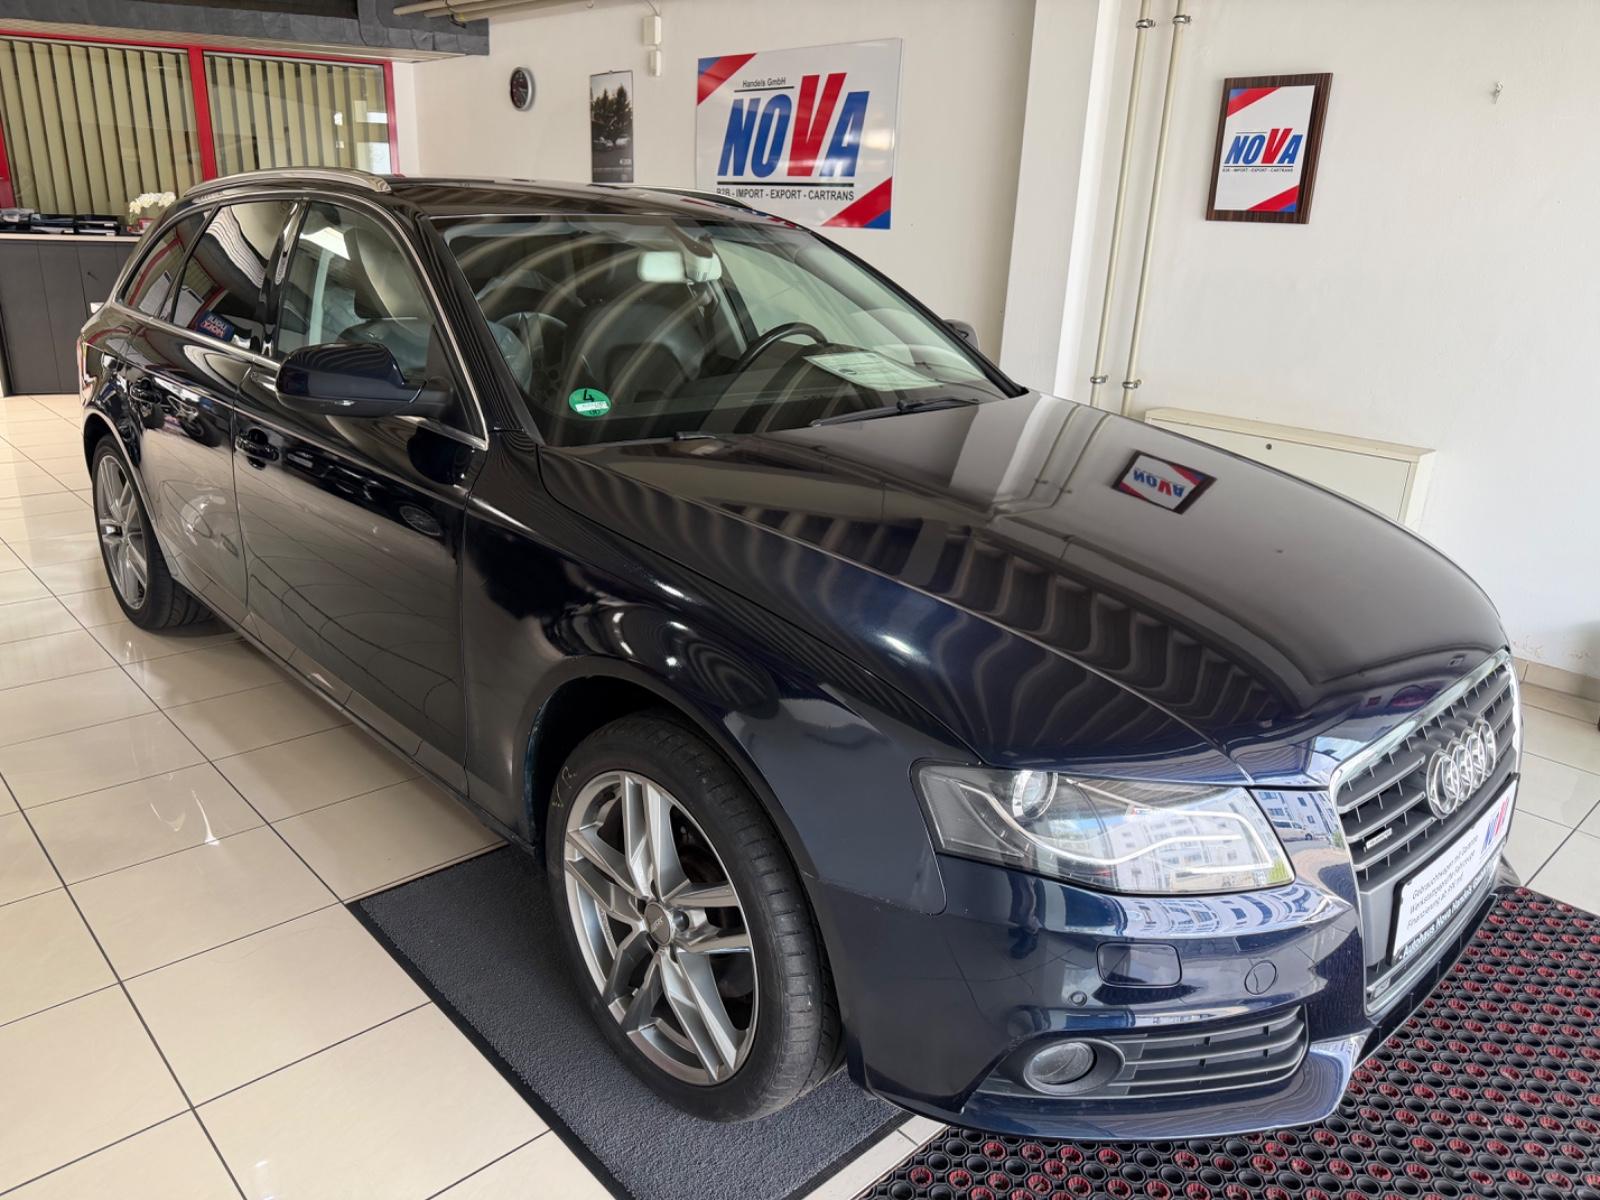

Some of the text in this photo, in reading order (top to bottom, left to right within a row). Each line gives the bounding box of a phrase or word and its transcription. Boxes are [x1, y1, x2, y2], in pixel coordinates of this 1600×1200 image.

[742, 77, 787, 88] Handels GmbH
[717, 72, 870, 178] NOVA
[1224, 127, 1303, 165] NOVA
[735, 188, 764, 199] IMPORT
[770, 189, 802, 200] EXPORT
[808, 190, 855, 201] CARTRANS
[583, 389, 595, 403] 4
